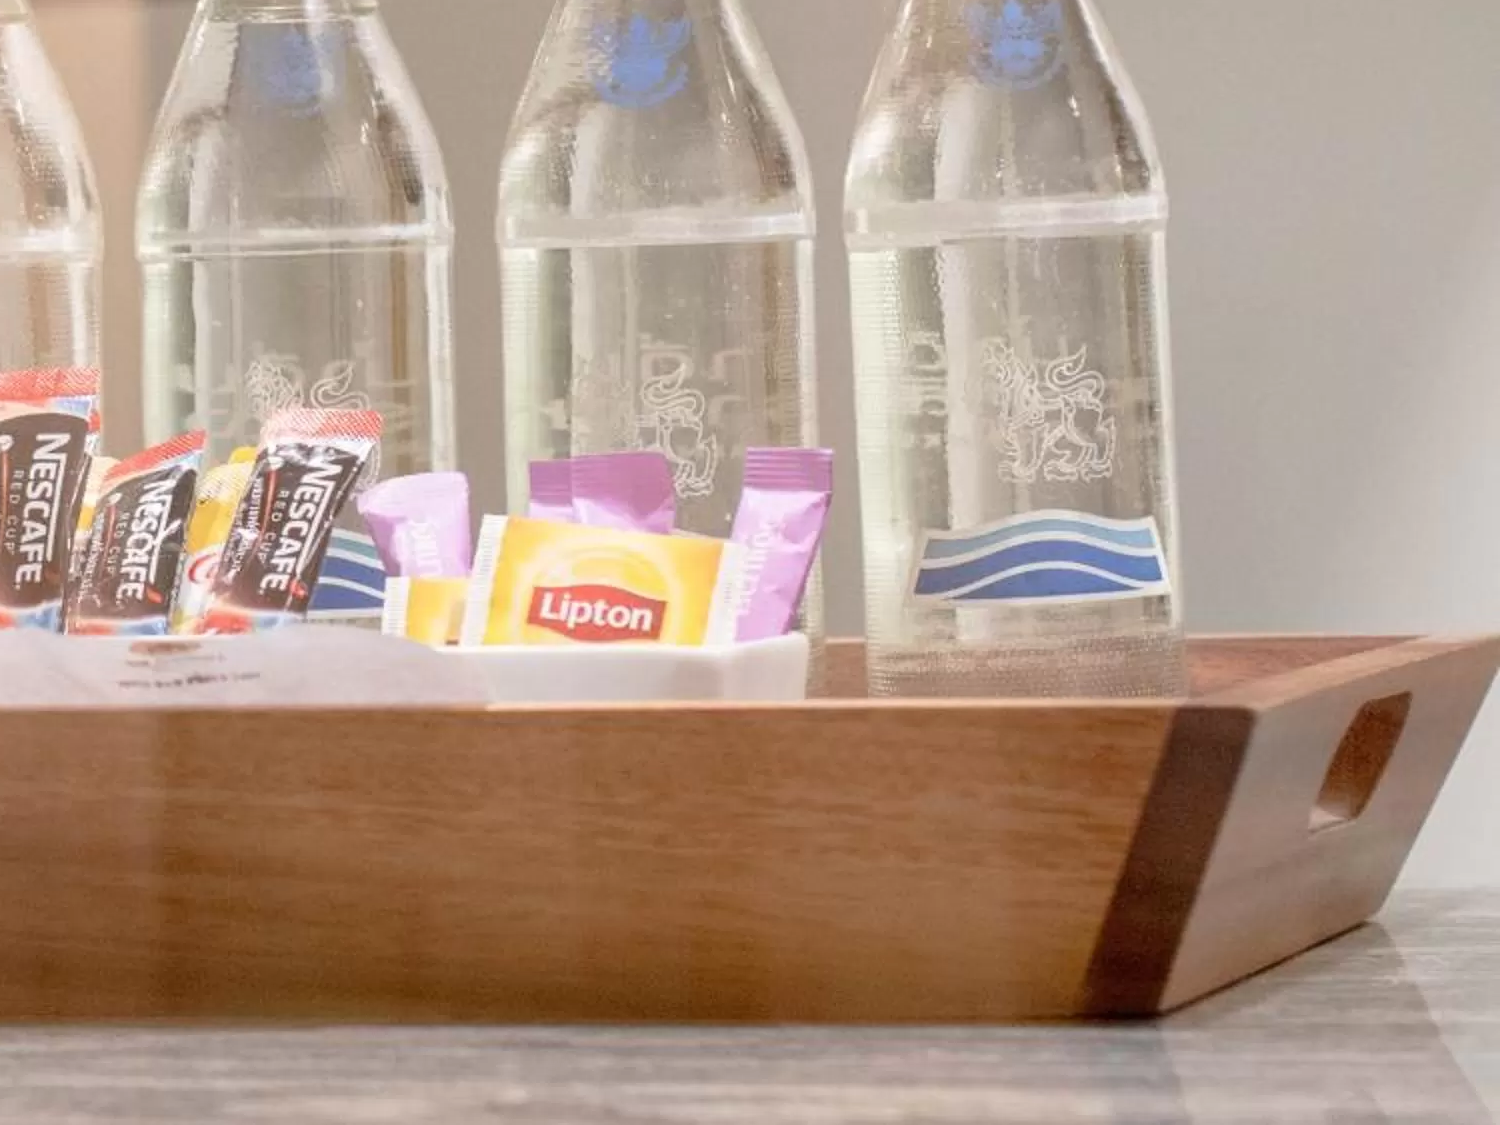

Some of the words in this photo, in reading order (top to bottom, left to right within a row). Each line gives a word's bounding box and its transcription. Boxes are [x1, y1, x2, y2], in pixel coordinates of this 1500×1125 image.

[9, 469, 25, 505] RED
[271, 489, 290, 523] RED
[4, 515, 18, 553] CUP
[257, 531, 277, 566] CUP
[539, 591, 653, 632] Lipton
